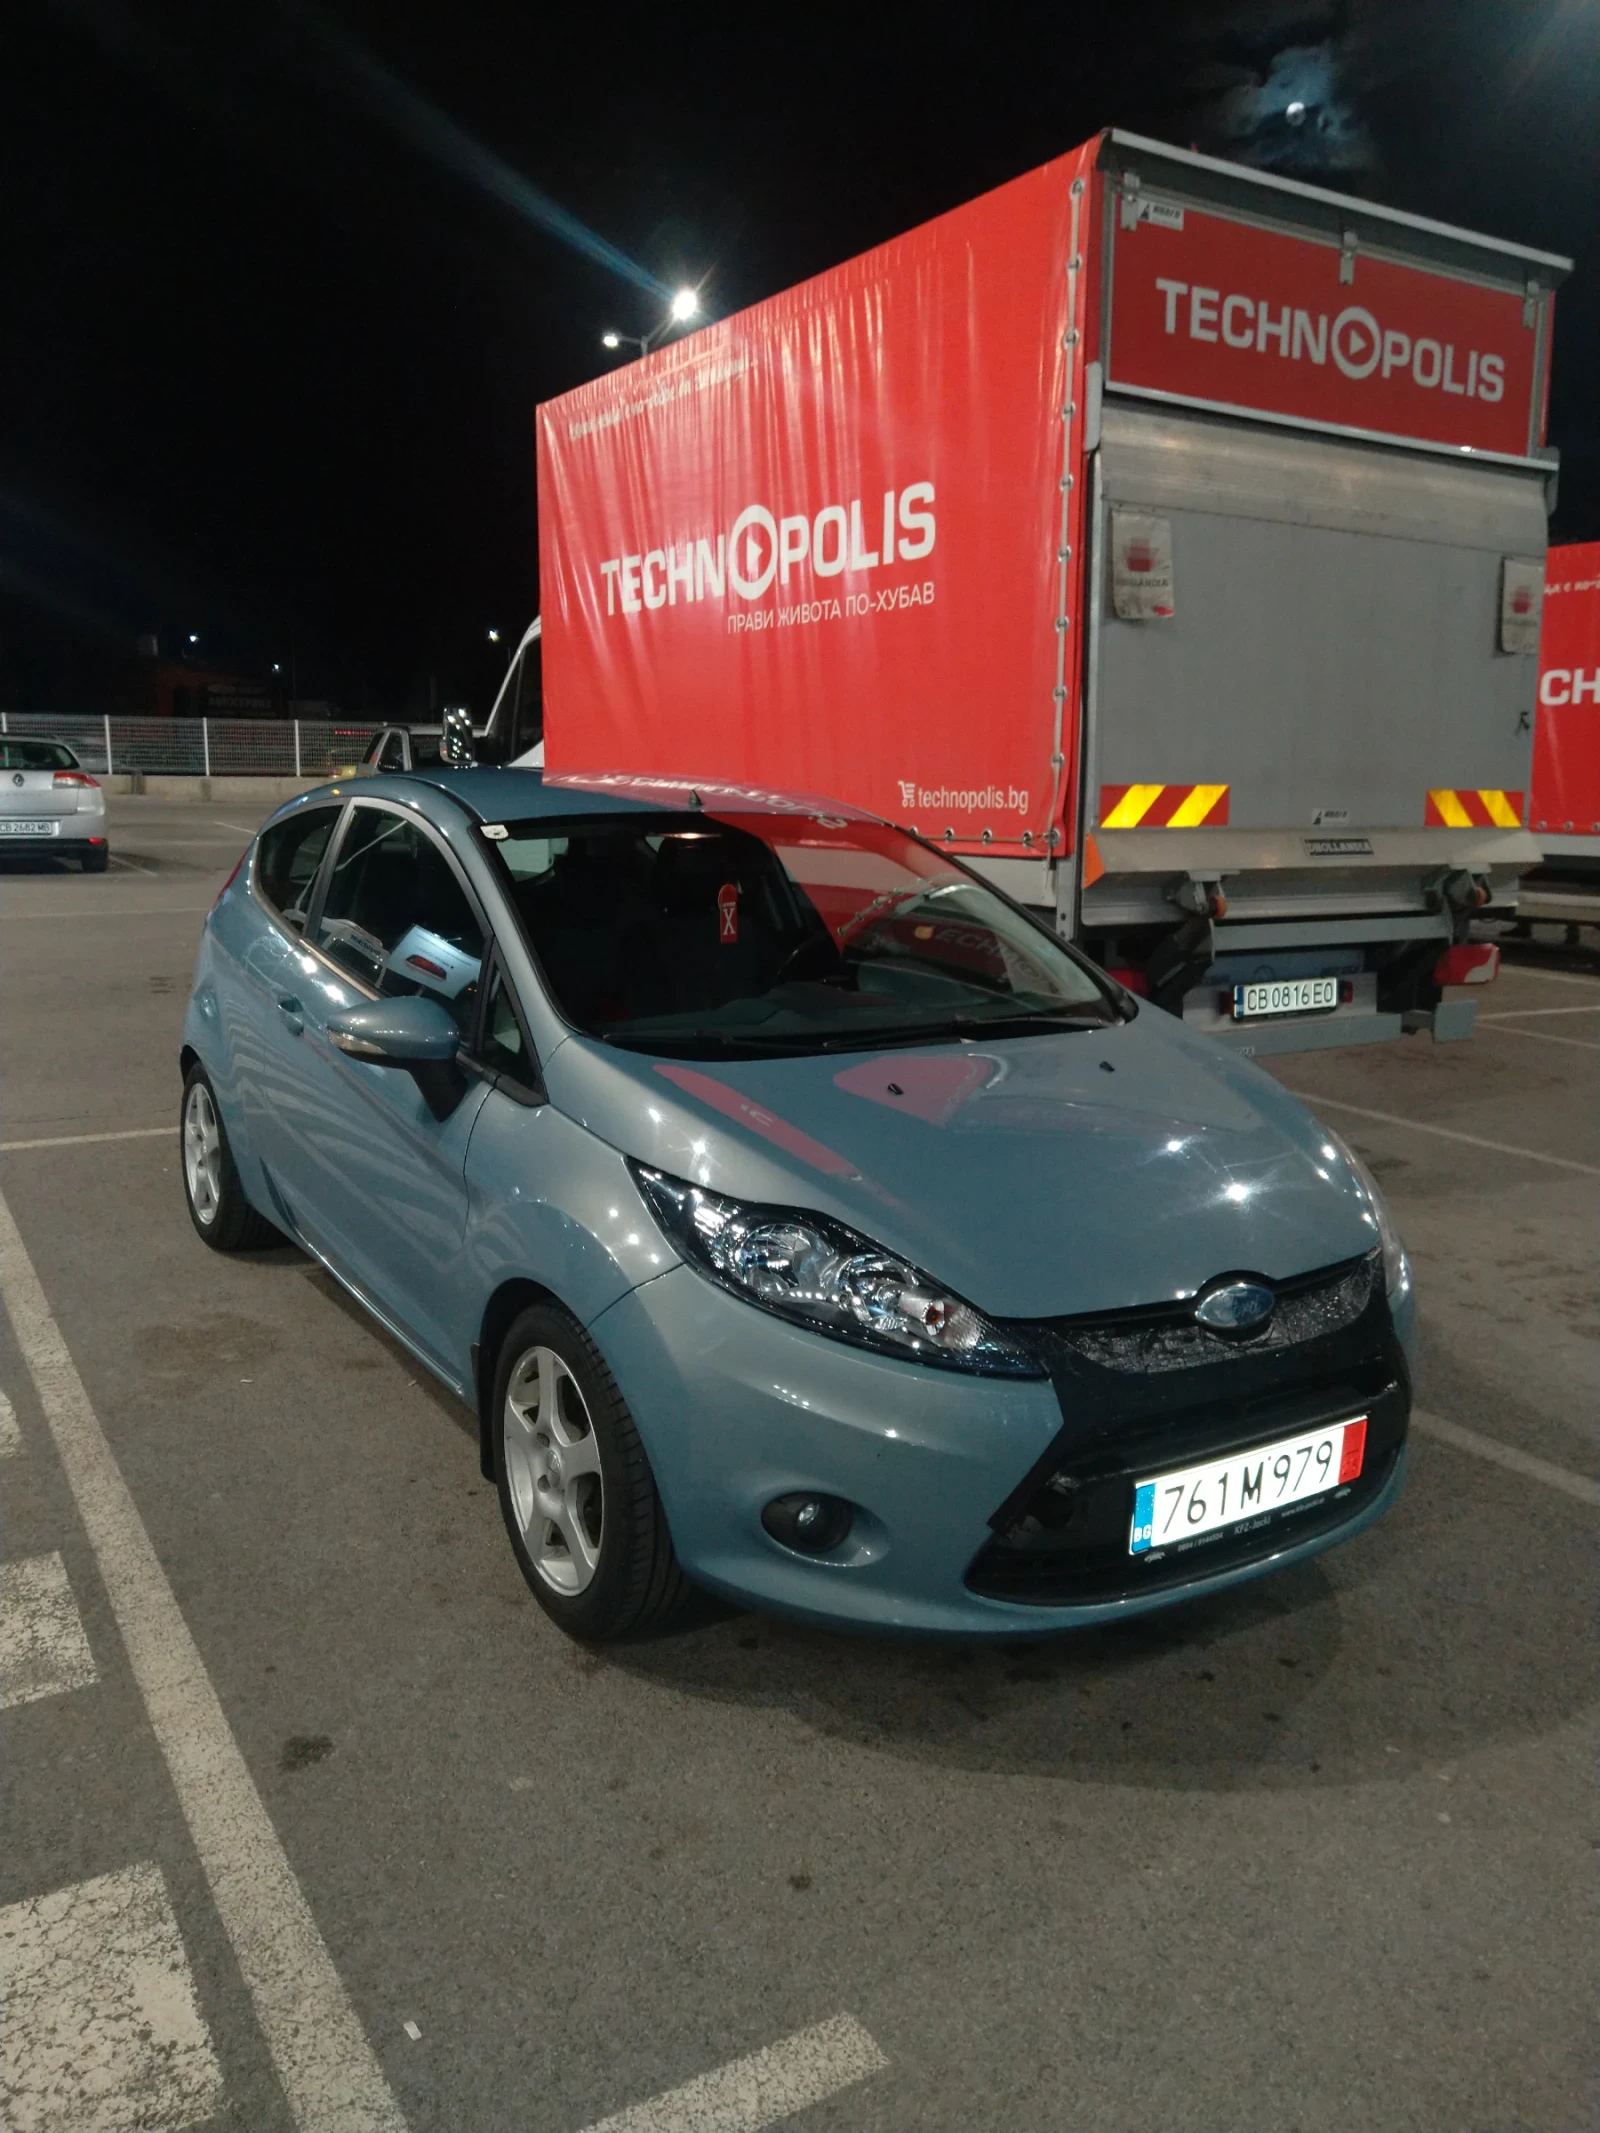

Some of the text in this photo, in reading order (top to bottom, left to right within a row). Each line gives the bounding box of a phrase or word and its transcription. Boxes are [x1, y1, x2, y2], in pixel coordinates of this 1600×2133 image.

[1155, 277, 1505, 402] TECHNOPOLIS
[600, 481, 936, 616] TECHNOPOLIS
[728, 581, 935, 634] ПРАВИ ЖИВОТА ПО-ХУБАВ
[918, 785, 1029, 815] technopolis.bg
[1247, 988, 1268, 1011] CB
[1271, 985, 1310, 1008] 0816
[1163, 1440, 1333, 1534] 761M979
[1133, 1524, 1152, 1543] BG
